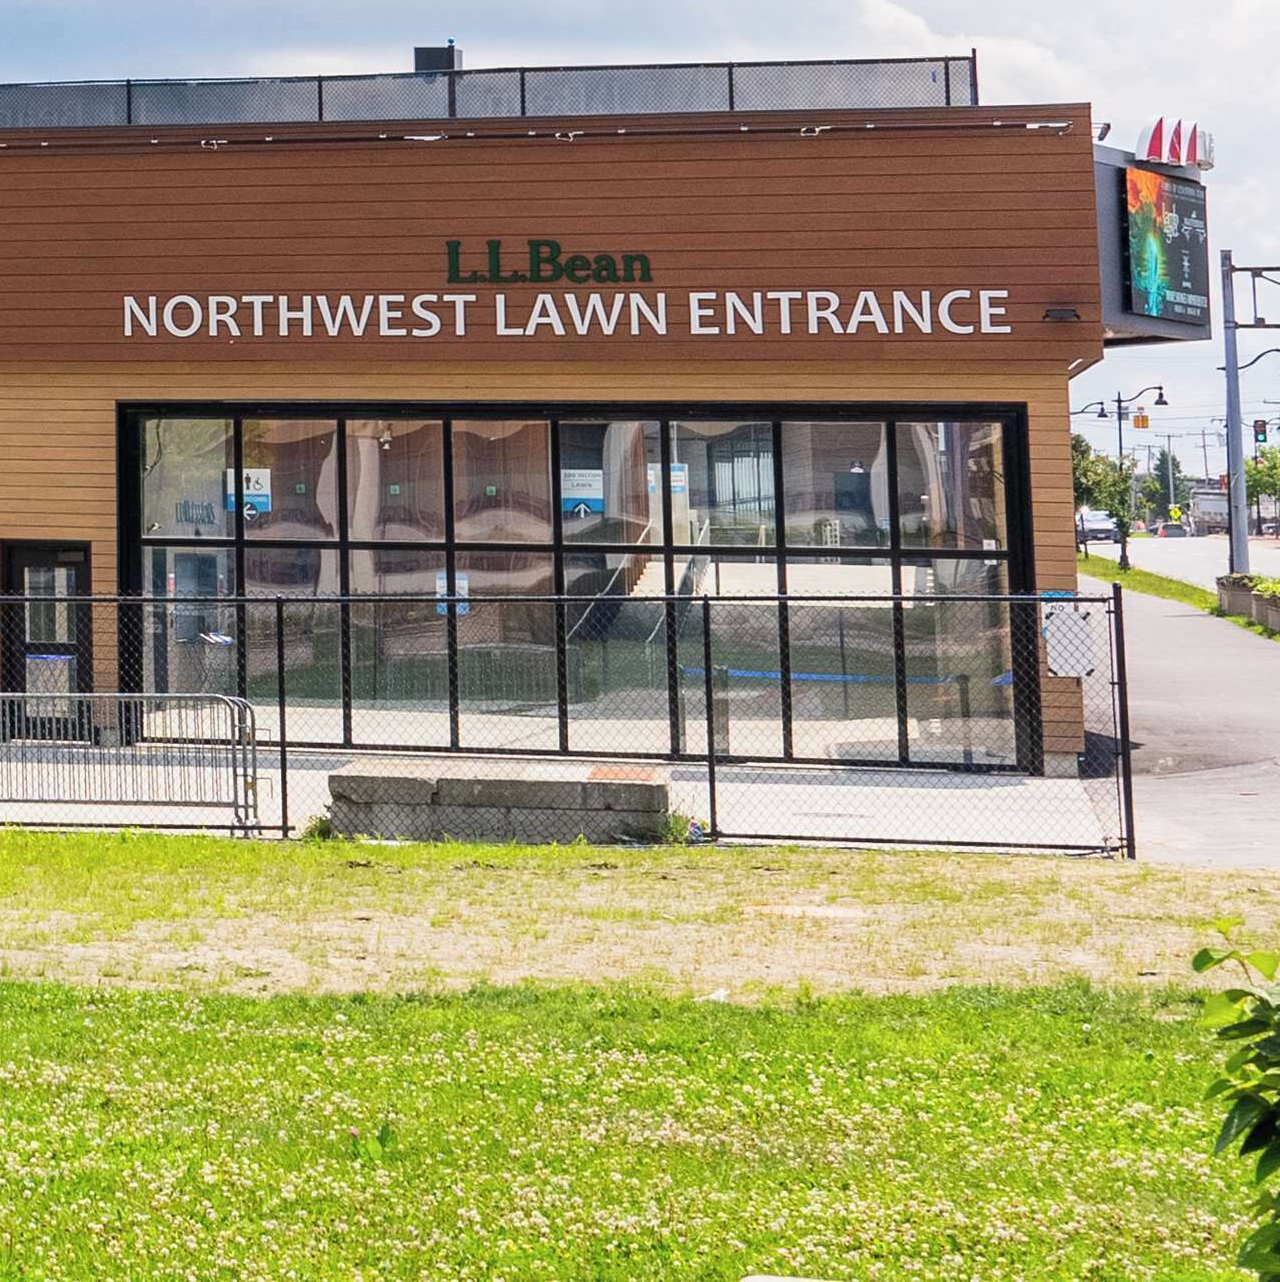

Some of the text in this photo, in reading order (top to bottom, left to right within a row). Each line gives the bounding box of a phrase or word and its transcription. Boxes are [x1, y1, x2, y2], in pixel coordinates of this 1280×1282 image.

[445, 239, 653, 284] L.L.Bean
[123, 289, 1012, 338] NORTHWEST LAWN ENTRANCE
